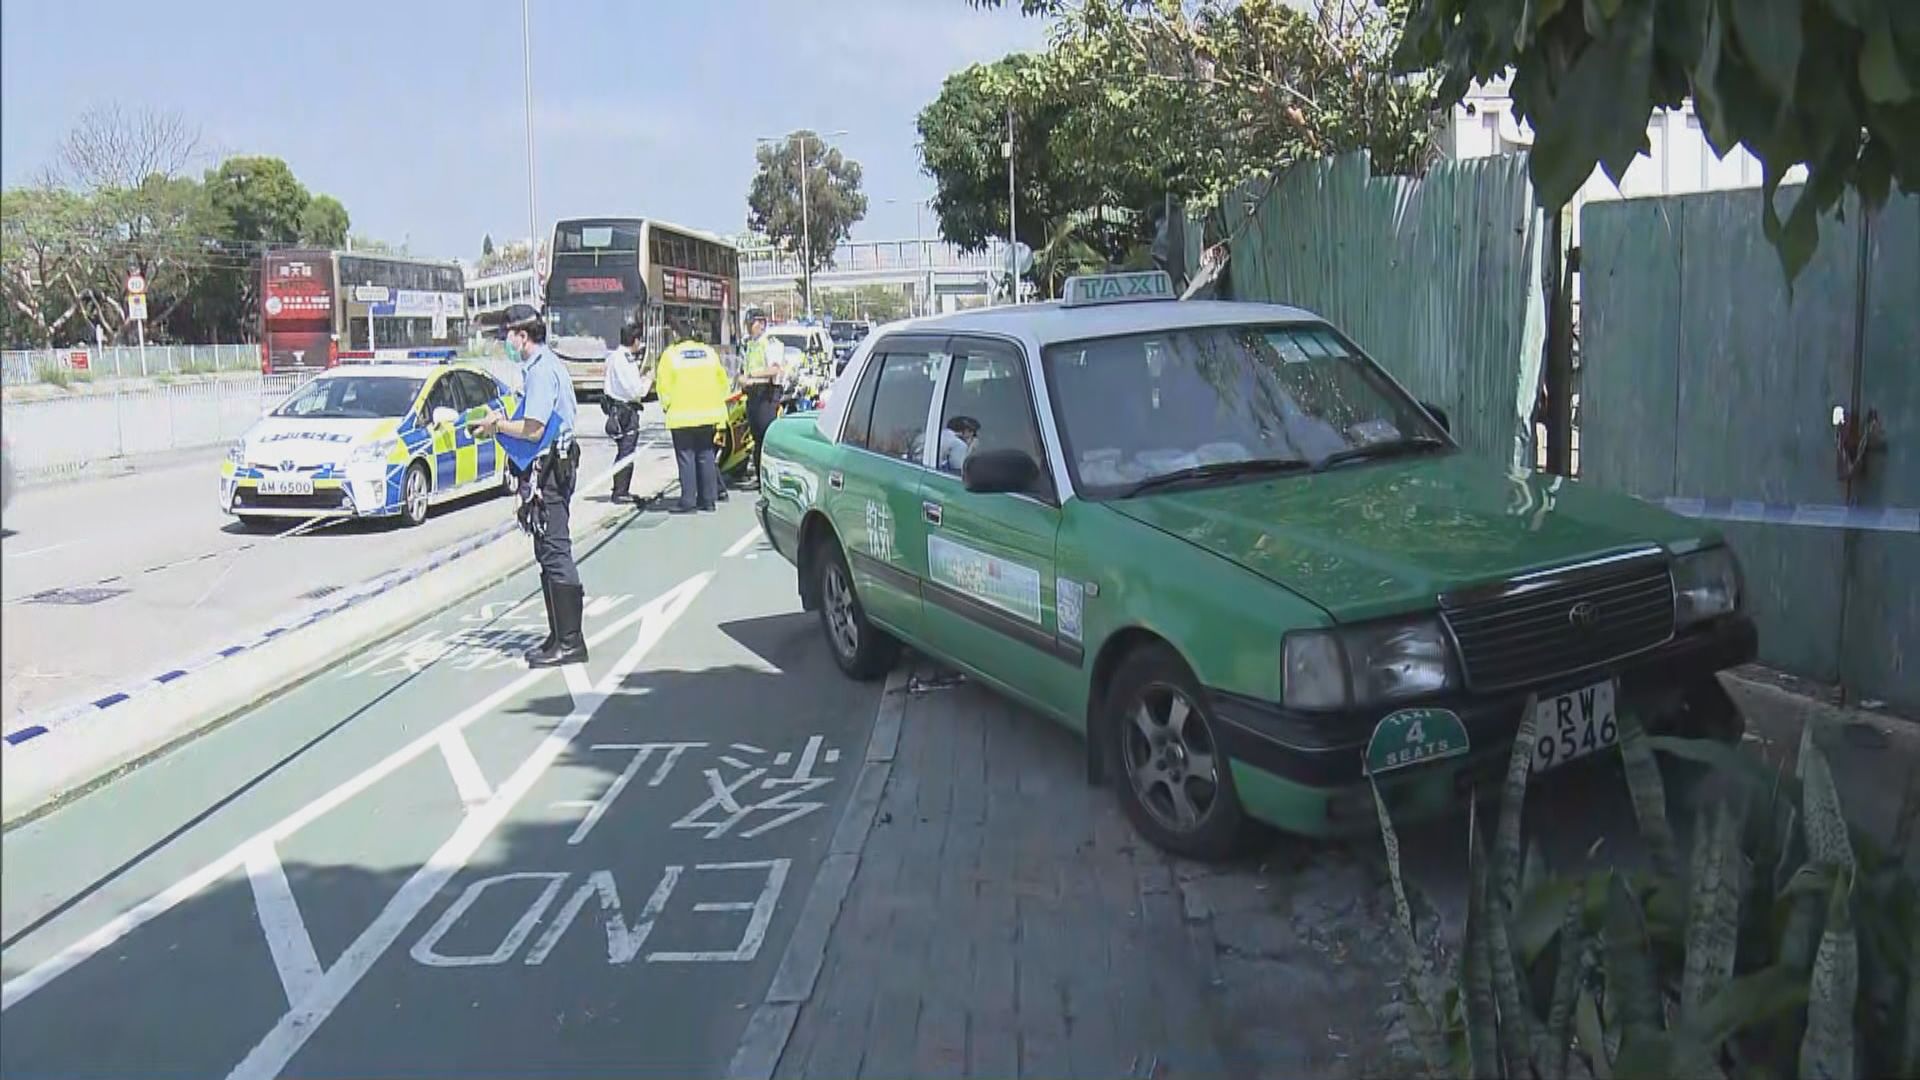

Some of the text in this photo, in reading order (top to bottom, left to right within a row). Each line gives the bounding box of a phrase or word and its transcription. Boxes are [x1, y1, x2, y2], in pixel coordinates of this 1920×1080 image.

[1080, 274, 1166, 299] TAXI
[261, 482, 311, 493] AM 6500
[867, 528, 891, 562] TAXI
[459, 594, 634, 621] SLW
[1557, 687, 1596, 729] RW
[1406, 720, 1425, 743] 4
[1538, 712, 1617, 767] 9546
[1386, 740, 1449, 765] SEATS
[548, 736, 841, 845] 終止
[410, 858, 792, 967] END
